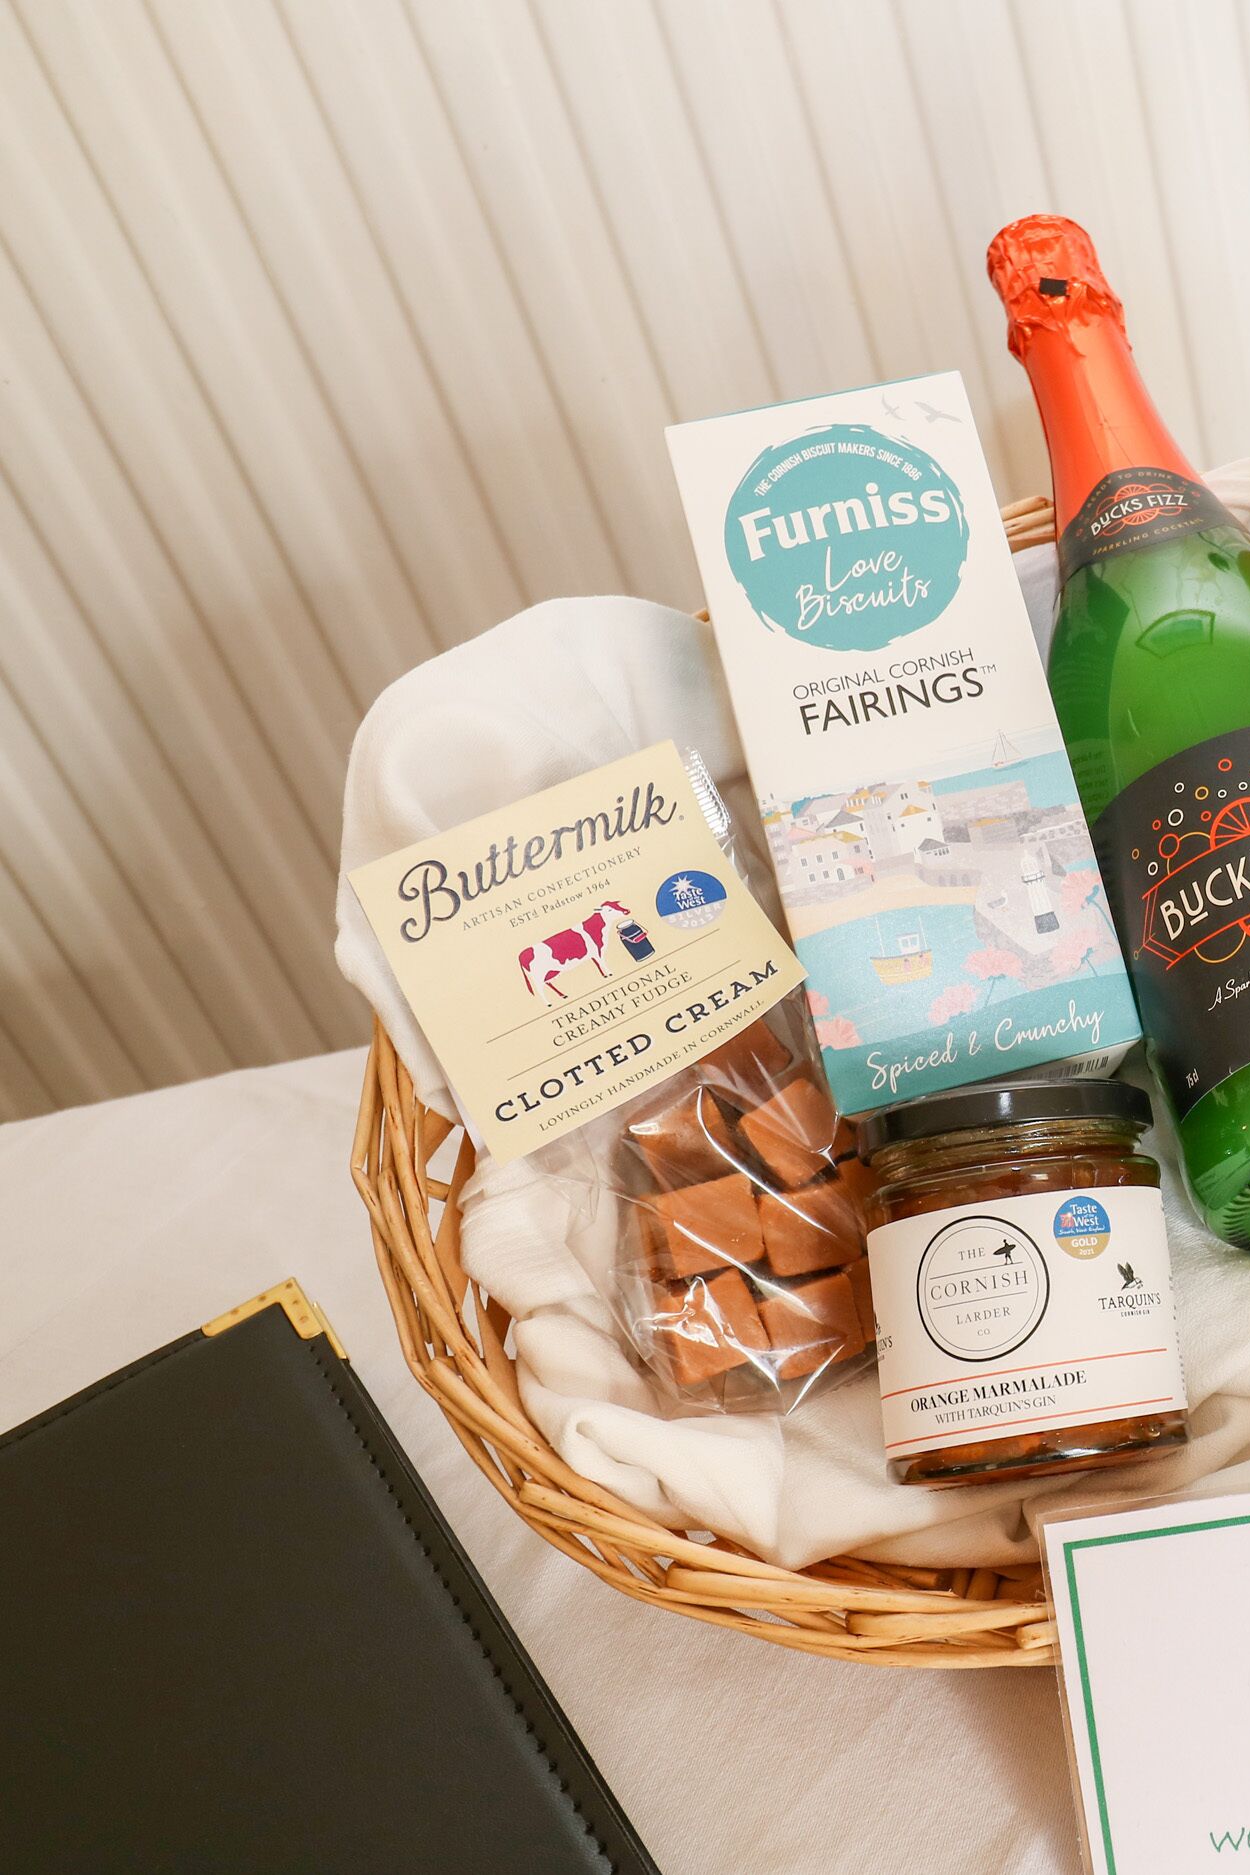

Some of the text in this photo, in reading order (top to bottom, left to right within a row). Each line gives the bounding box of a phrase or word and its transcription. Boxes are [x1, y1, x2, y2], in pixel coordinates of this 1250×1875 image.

[754, 442, 923, 497] THE CORNISH BISCUIT MAKERS SINCE 1886
[1117, 472, 1133, 480] TO
[1138, 471, 1173, 480] DRINK
[738, 482, 951, 562] Furniss
[1090, 494, 1189, 537] BUCKS FIZZ
[1092, 533, 1149, 556] SPARKLING
[824, 546, 903, 592] Love
[795, 567, 931, 631] Biscuits
[793, 647, 974, 700] ORIGINAL CORNISH
[397, 782, 677, 943] Buttermilk
[462, 846, 642, 931] ARTISAN CONFECTIONERY
[542, 890, 584, 914] Padstow
[586, 878, 611, 897] 1964
[673, 887, 704, 901] Taste
[676, 896, 706, 910] West
[668, 902, 722, 923] SILVER
[552, 963, 678, 1030] TRADITIONAL
[552, 971, 693, 1048] CREAMY FUDGE
[1208, 987, 1222, 1012] A
[495, 959, 779, 1122] CLOTTED CREAM
[866, 1032, 958, 1094] Spiced
[993, 999, 1105, 1051] Crunchy
[539, 1000, 765, 1132] LOVINGLY HANDMADE IN CORNWALL
[1070, 1203, 1098, 1215] Taste
[1072, 1217, 1099, 1227] West
[958, 1247, 986, 1261] THE
[1071, 1237, 1098, 1248] GOLD
[930, 1270, 1028, 1301] CORNISH
[1098, 1292, 1161, 1310] TARQUIN'S
[956, 1306, 1011, 1325] LARDER
[910, 1370, 1087, 1413] ORANGE MARMALADE
[935, 1395, 1056, 1425] WITH TARQUIN'S GIN
